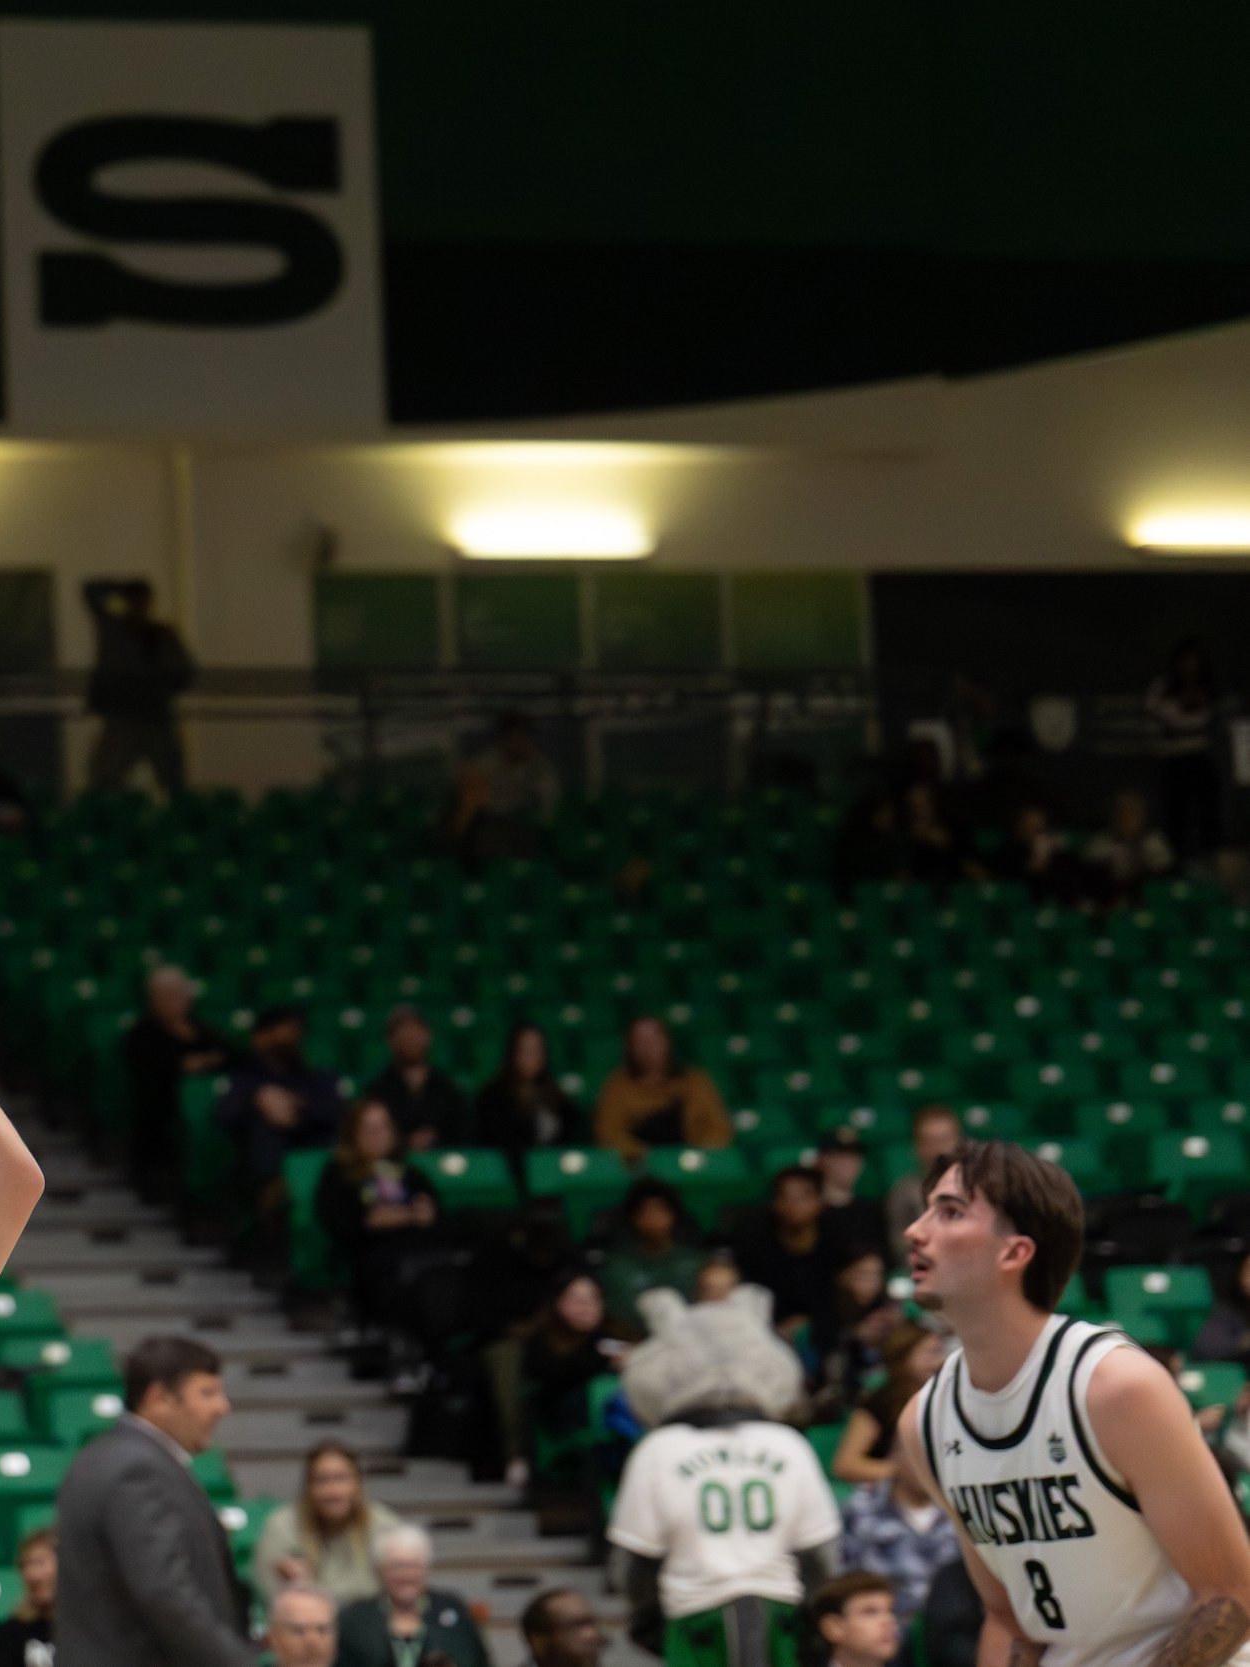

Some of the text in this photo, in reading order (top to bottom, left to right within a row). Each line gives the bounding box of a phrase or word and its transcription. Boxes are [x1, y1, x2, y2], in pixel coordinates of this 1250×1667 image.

[33, 113, 347, 331] S
[699, 1477, 776, 1533] 00
[950, 1473, 1097, 1547] HUSKIES
[1023, 1558, 1069, 1630] 8
